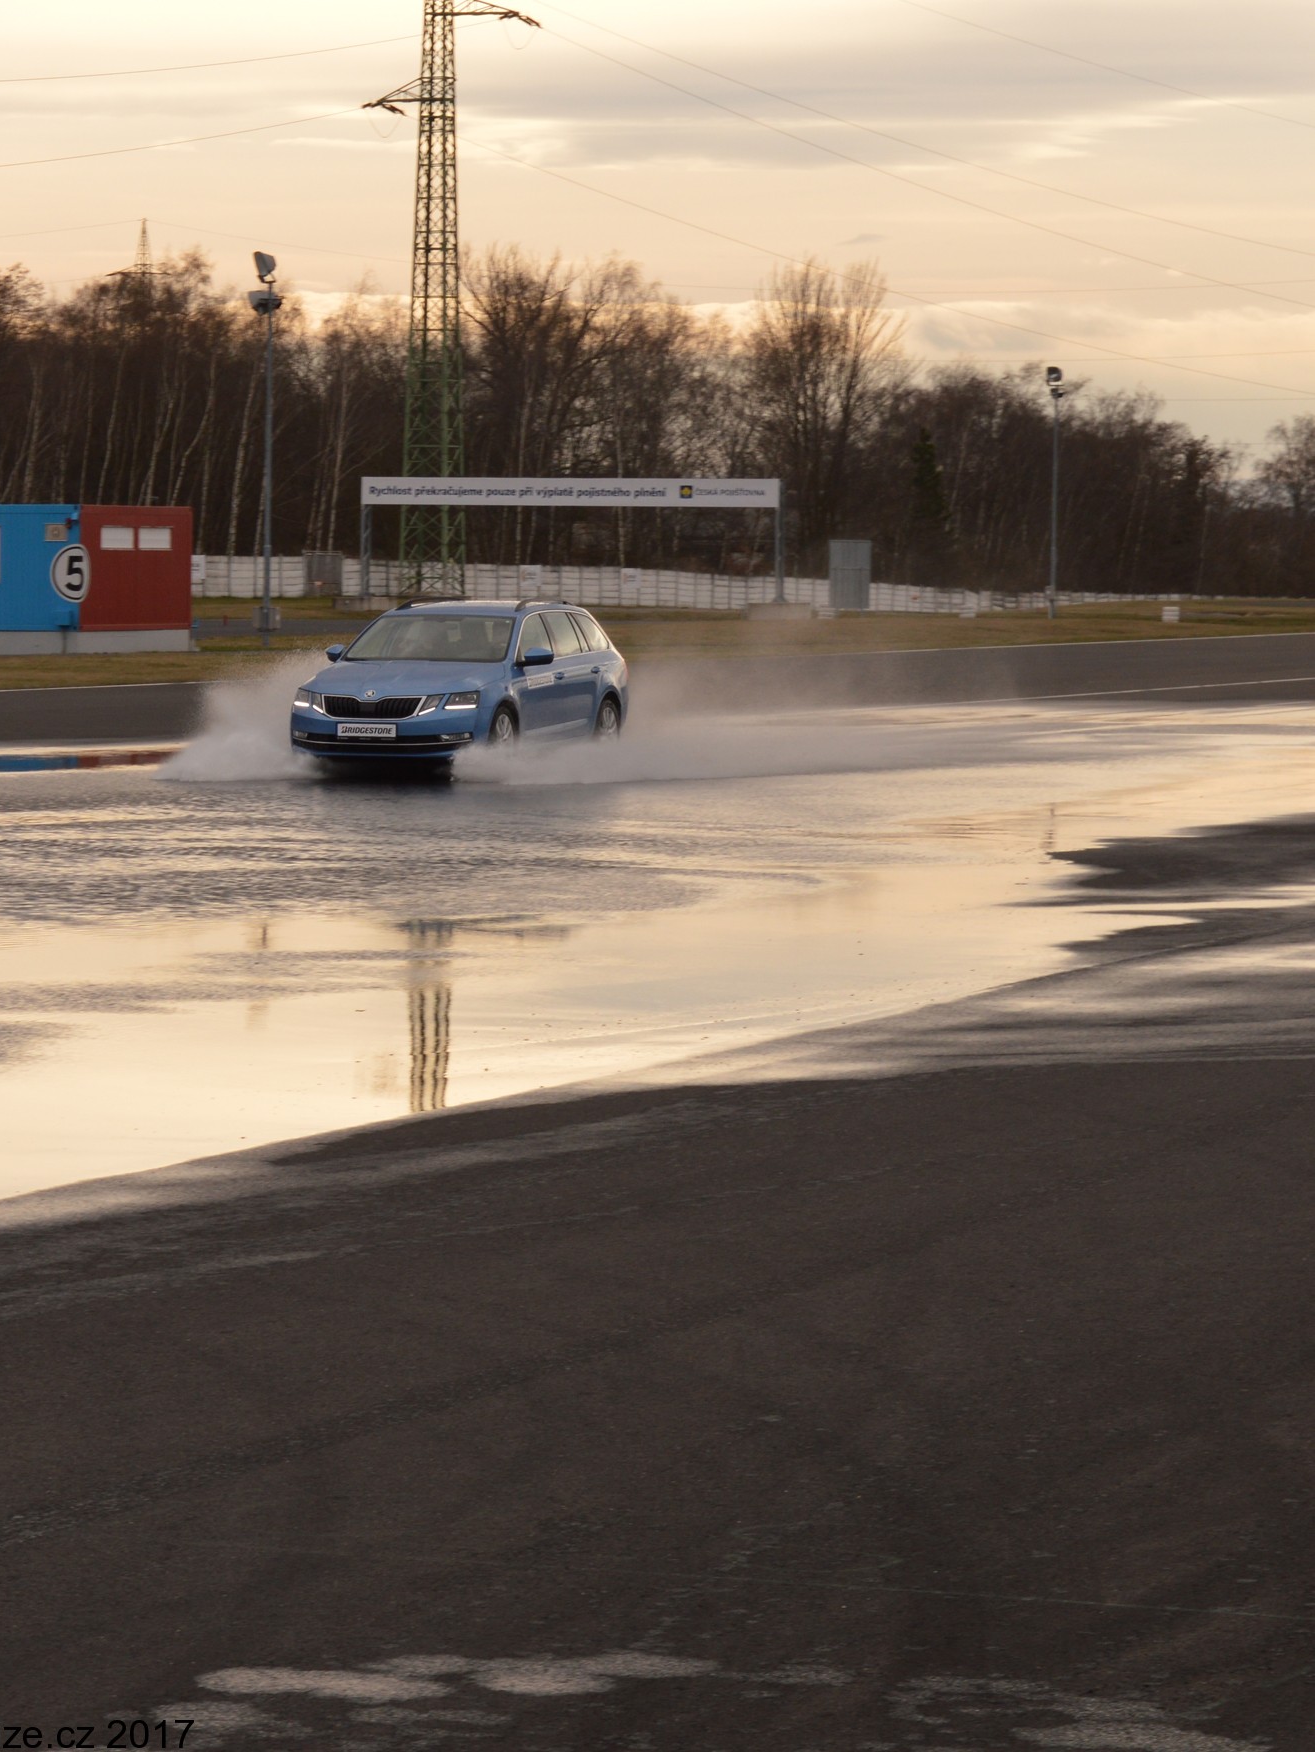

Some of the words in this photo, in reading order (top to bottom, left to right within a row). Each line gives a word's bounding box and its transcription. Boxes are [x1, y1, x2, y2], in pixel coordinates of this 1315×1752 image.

[369, 485, 412, 497] Rychlost
[414, 486, 482, 498] překračujeme
[486, 488, 516, 498] pouze
[519, 486, 533, 498] při
[535, 486, 574, 498] výplatě
[576, 487, 631, 499] pojistného
[633, 487, 667, 499] plnění
[66, 555, 84, 591] 5
[341, 725, 393, 735] BRIDGESTONE
